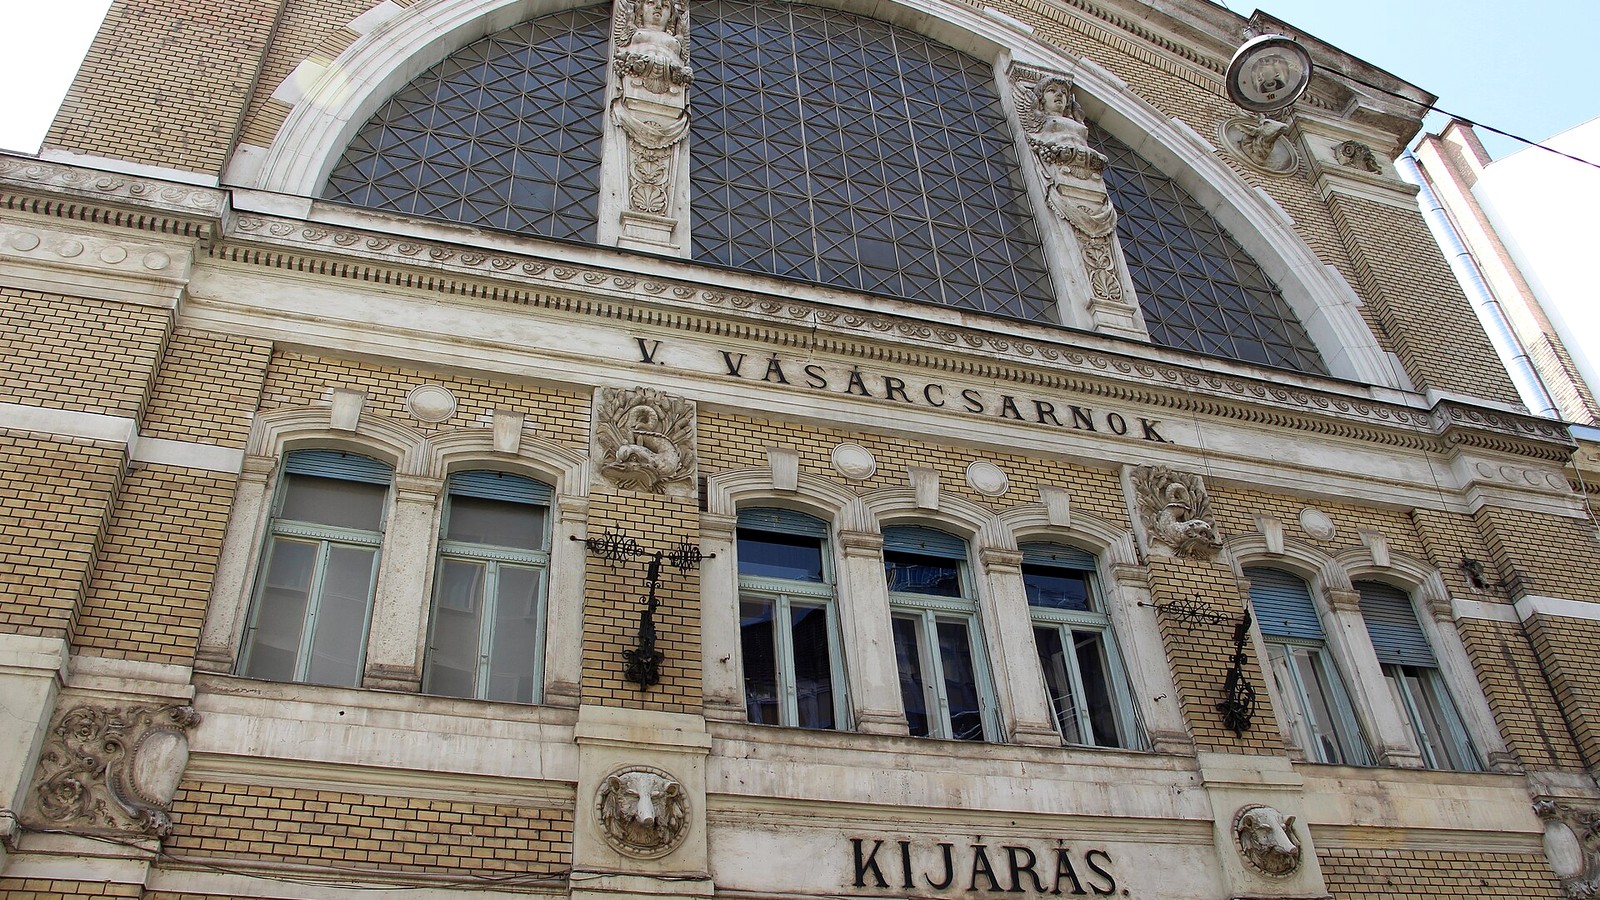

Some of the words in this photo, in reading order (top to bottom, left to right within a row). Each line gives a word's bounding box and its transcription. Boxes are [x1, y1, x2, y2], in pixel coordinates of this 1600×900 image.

[633, 337, 665, 365] V.
[718, 350, 1175, 444] VÁSÁRCSARNOK.
[850, 835, 1130, 896] KIJÁRÁS.
